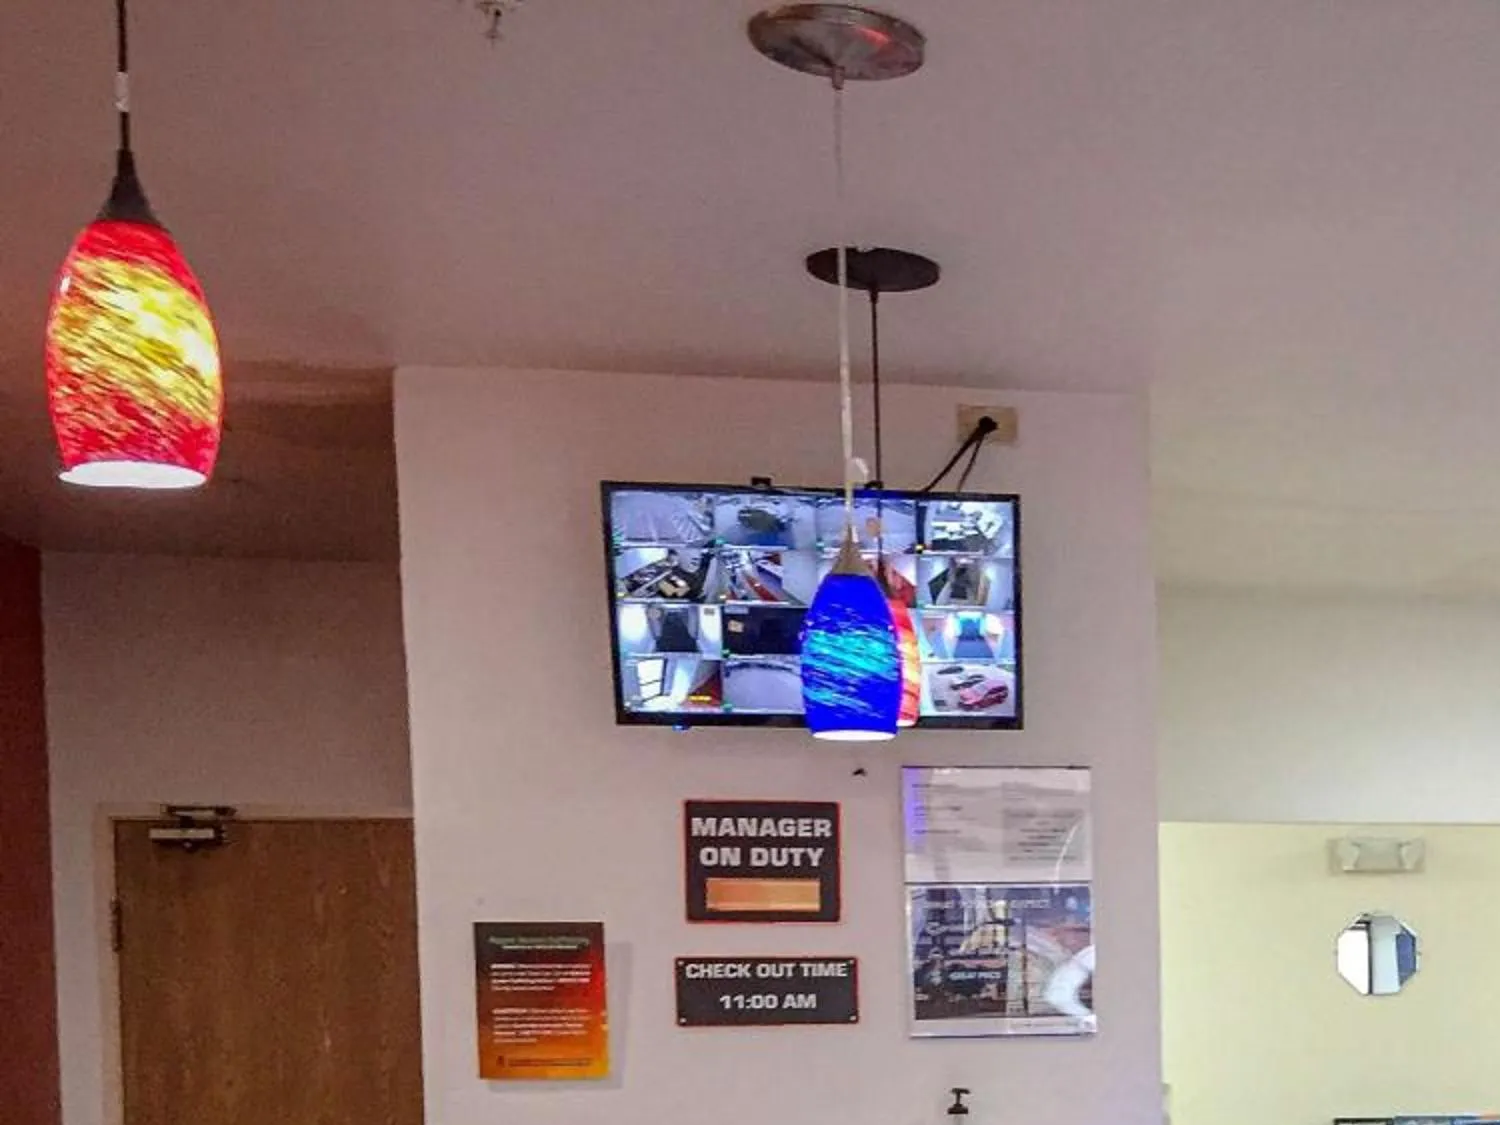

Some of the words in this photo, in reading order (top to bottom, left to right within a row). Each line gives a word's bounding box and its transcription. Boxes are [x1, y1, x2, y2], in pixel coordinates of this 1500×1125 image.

[691, 817, 832, 837] MANAGER
[699, 847, 741, 867] ON
[750, 847, 824, 867] DUTY
[685, 963, 752, 979] CHECK
[756, 963, 796, 978] OUT
[800, 962, 848, 977] TIME
[719, 994, 778, 1009] 11:00
[782, 993, 817, 1009] AM
